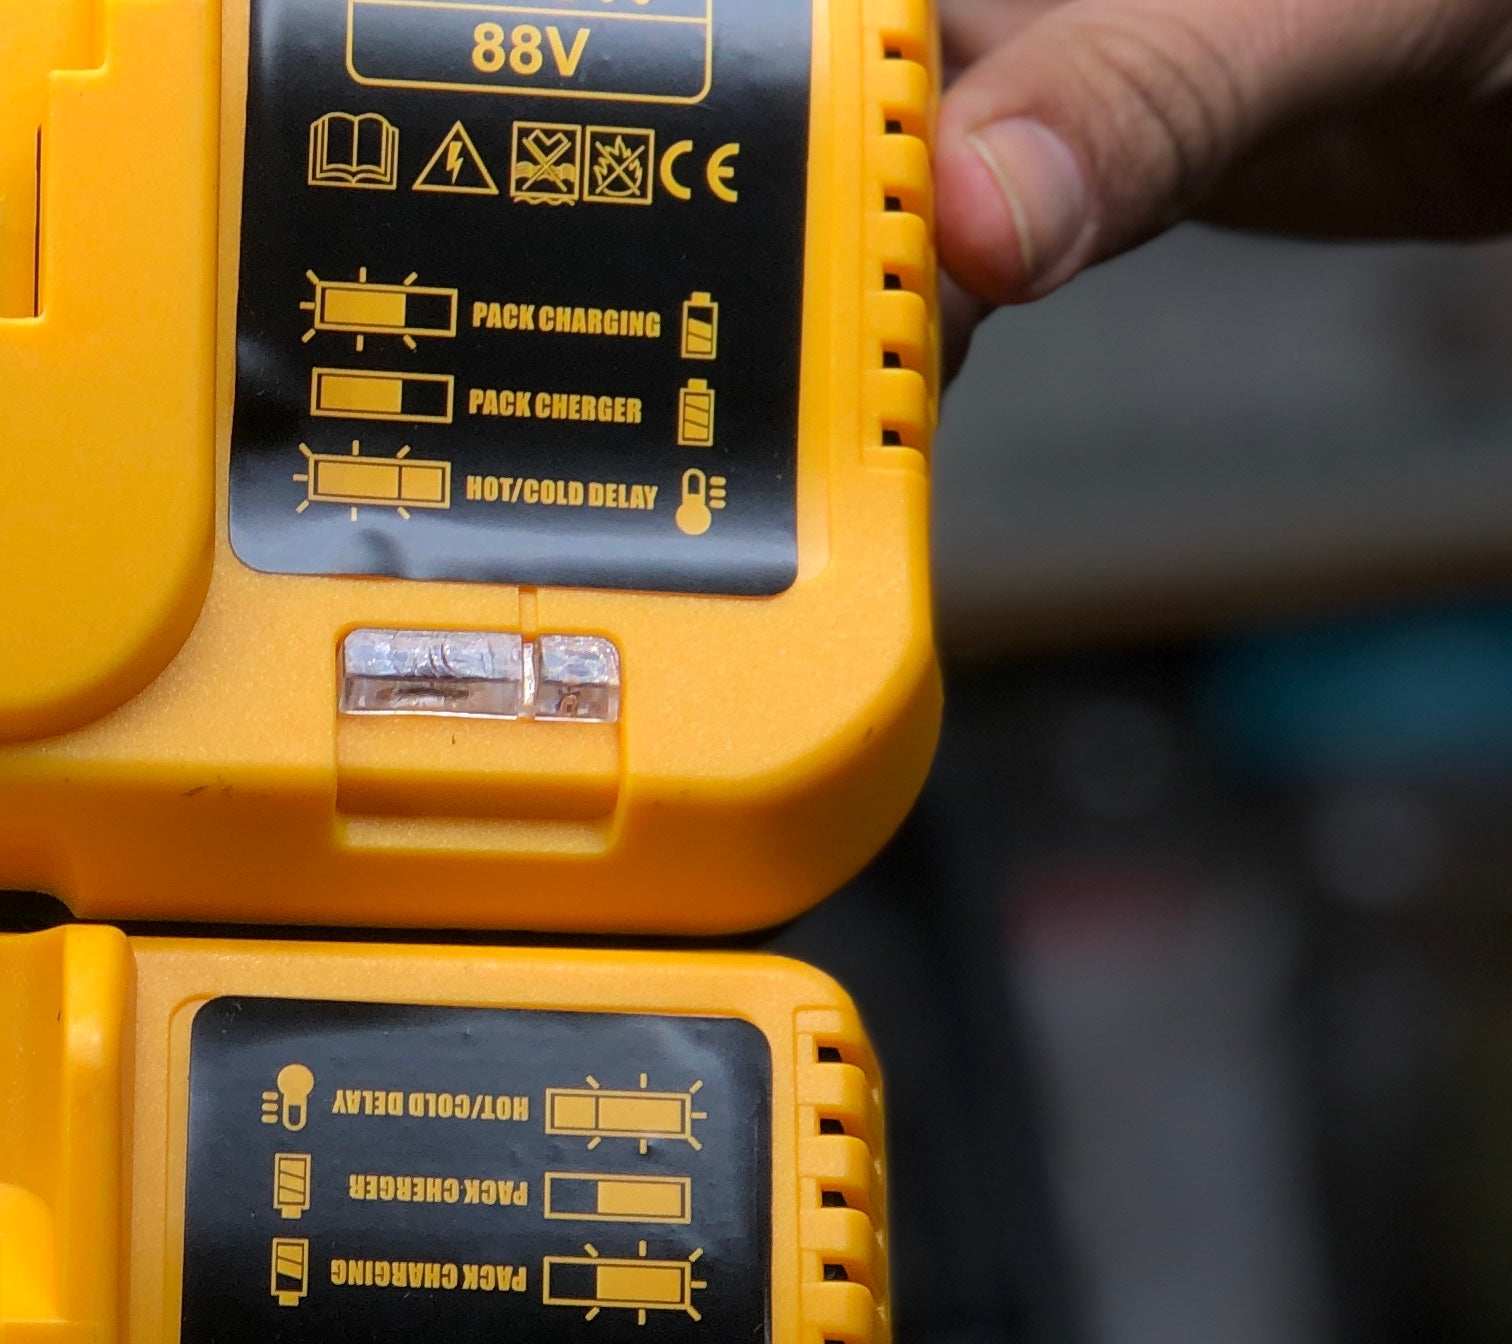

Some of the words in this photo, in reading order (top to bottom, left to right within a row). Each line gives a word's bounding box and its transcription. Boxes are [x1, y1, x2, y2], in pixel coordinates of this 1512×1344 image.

[471, 23, 590, 77] 88V
[472, 301, 536, 331] PACK
[538, 305, 661, 337] CHARGING
[468, 389, 530, 418] PACK
[535, 392, 642, 423] CHERGER
[465, 475, 585, 506] HOT/COLD
[589, 481, 659, 510] DELAY
[331, 1089, 404, 1115] DELAY
[408, 1093, 529, 1120] HOT/COLD
[348, 1174, 460, 1203] CHERGER
[464, 1177, 528, 1205] PACK
[330, 1259, 459, 1289] CHARGING
[463, 1263, 527, 1291] PACK
